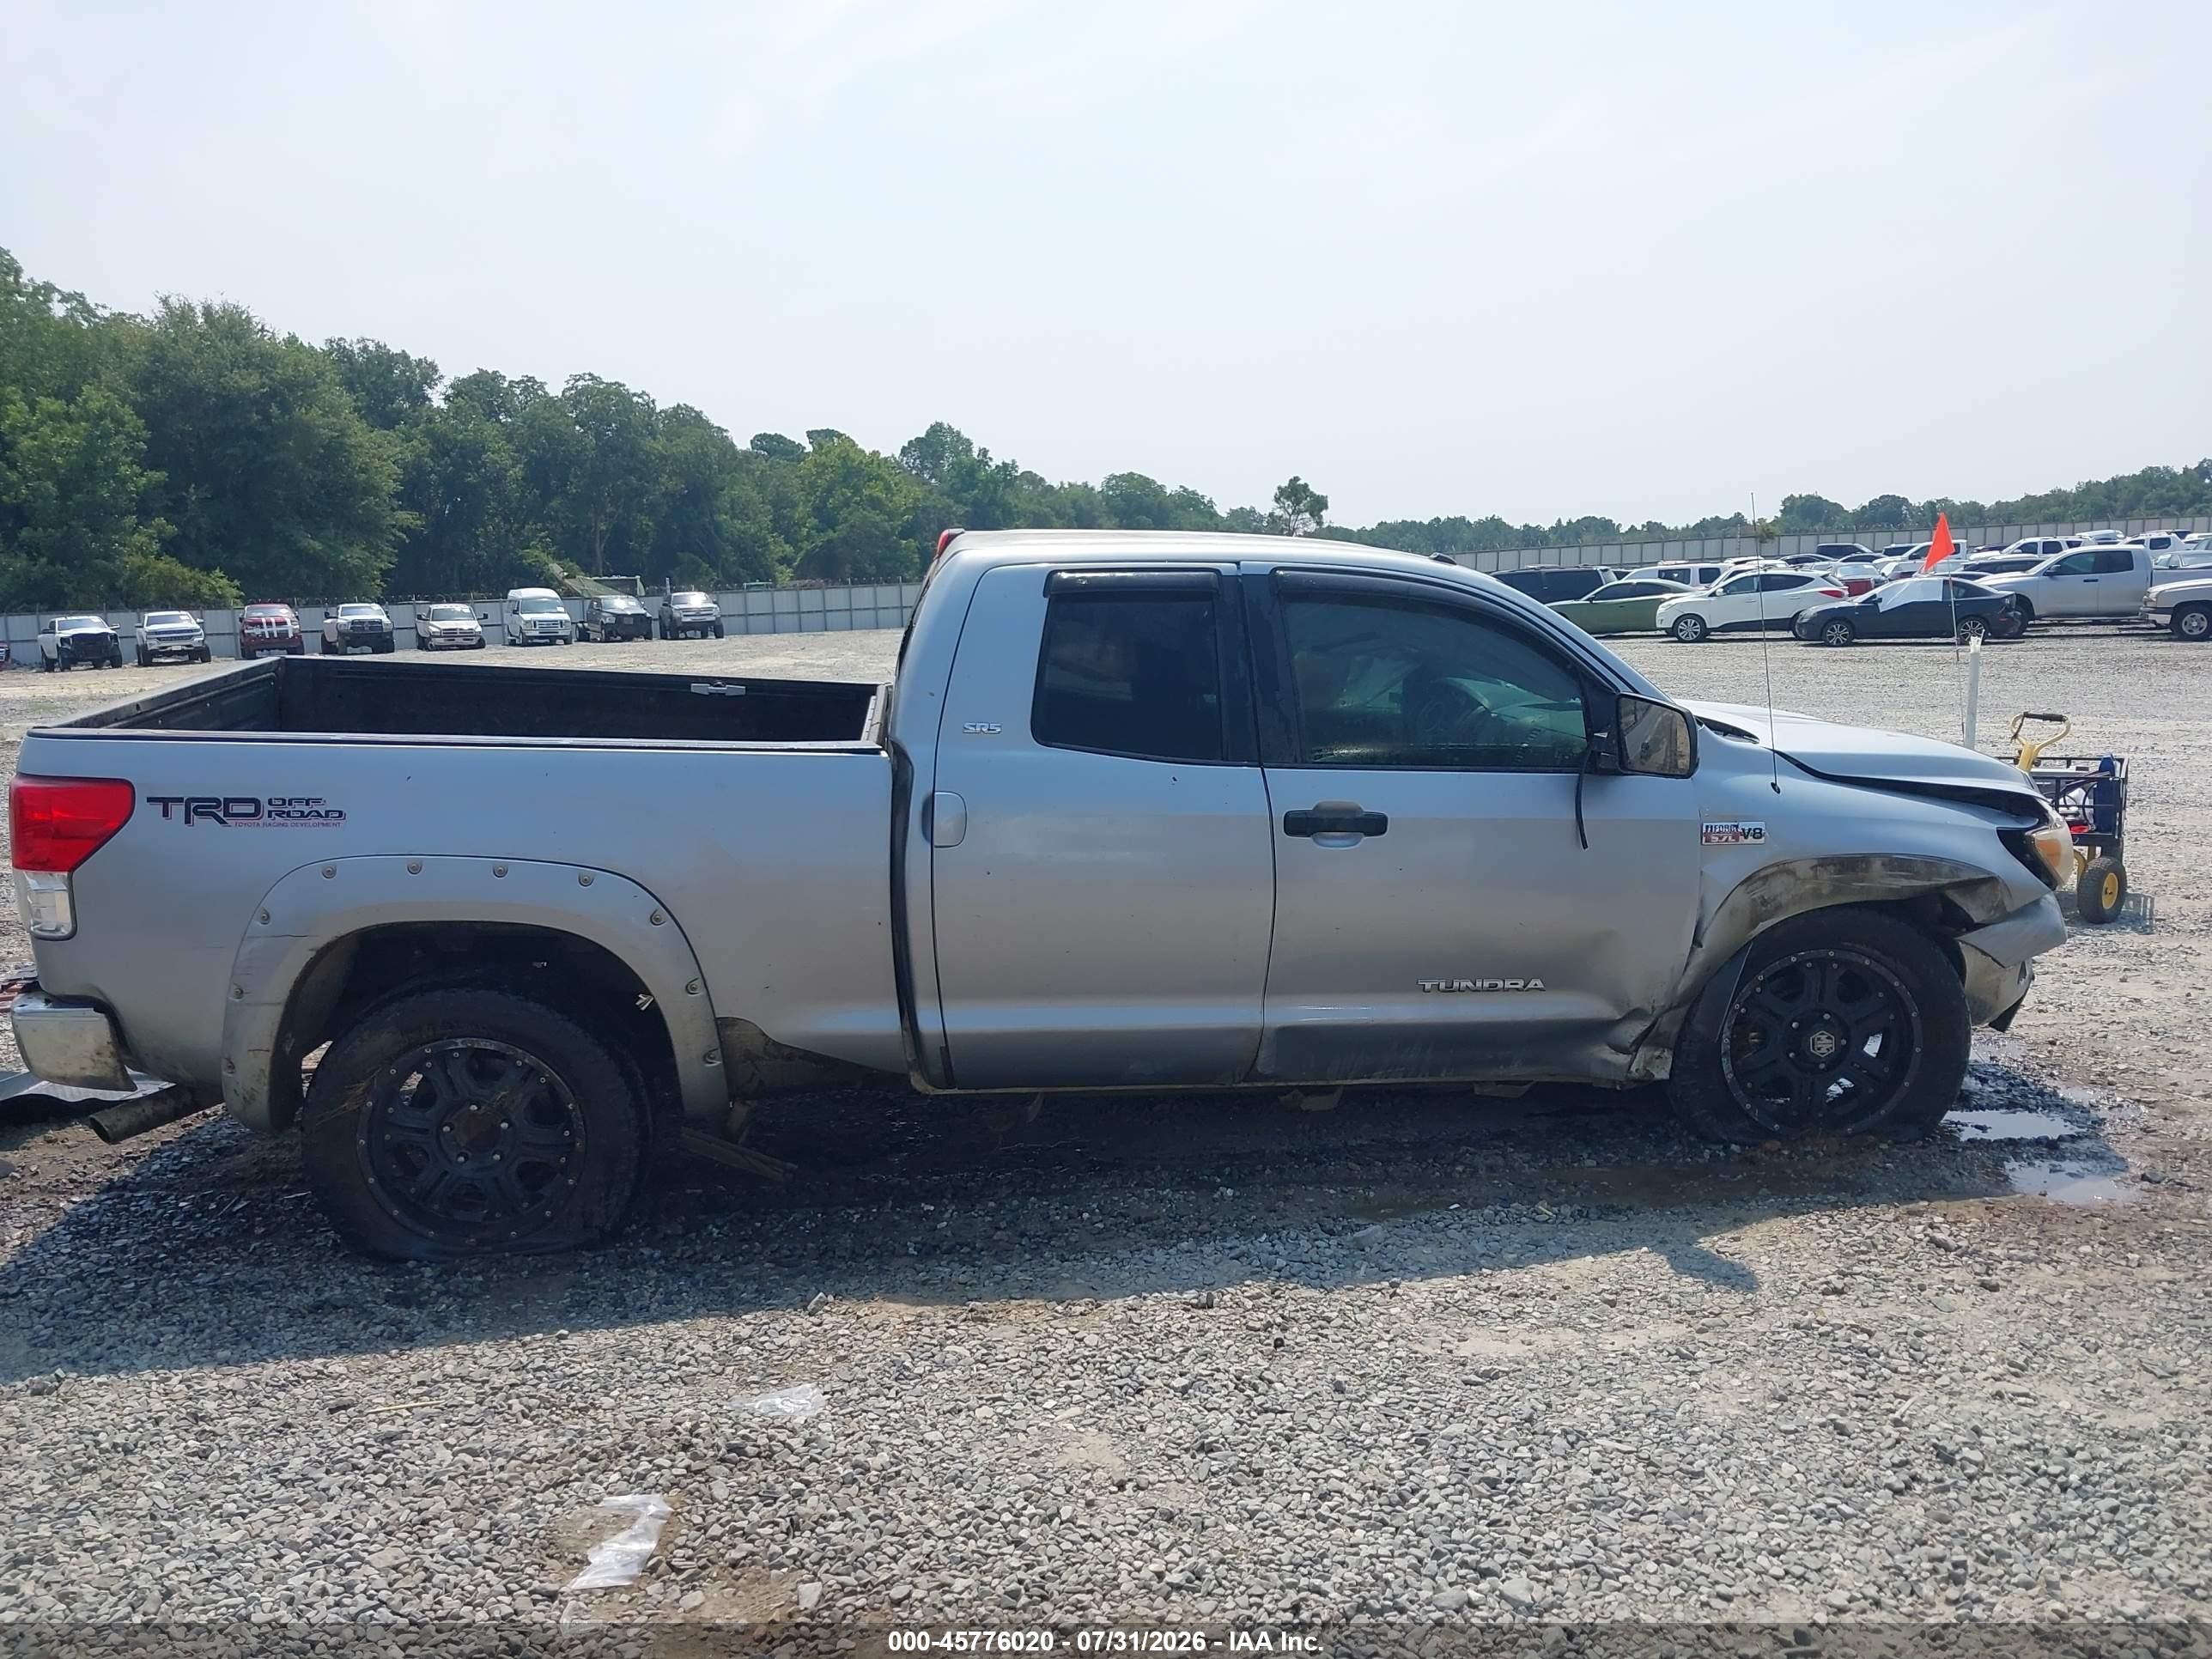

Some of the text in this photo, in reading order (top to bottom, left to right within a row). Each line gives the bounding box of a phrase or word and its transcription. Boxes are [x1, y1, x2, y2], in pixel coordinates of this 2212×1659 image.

[962, 720, 1002, 734] SR5
[267, 797, 324, 809] OFF
[146, 796, 264, 828] TRD
[267, 809, 347, 821] ROAD
[1741, 827, 1764, 840] V8
[1417, 977, 1547, 993] TUNDRA
